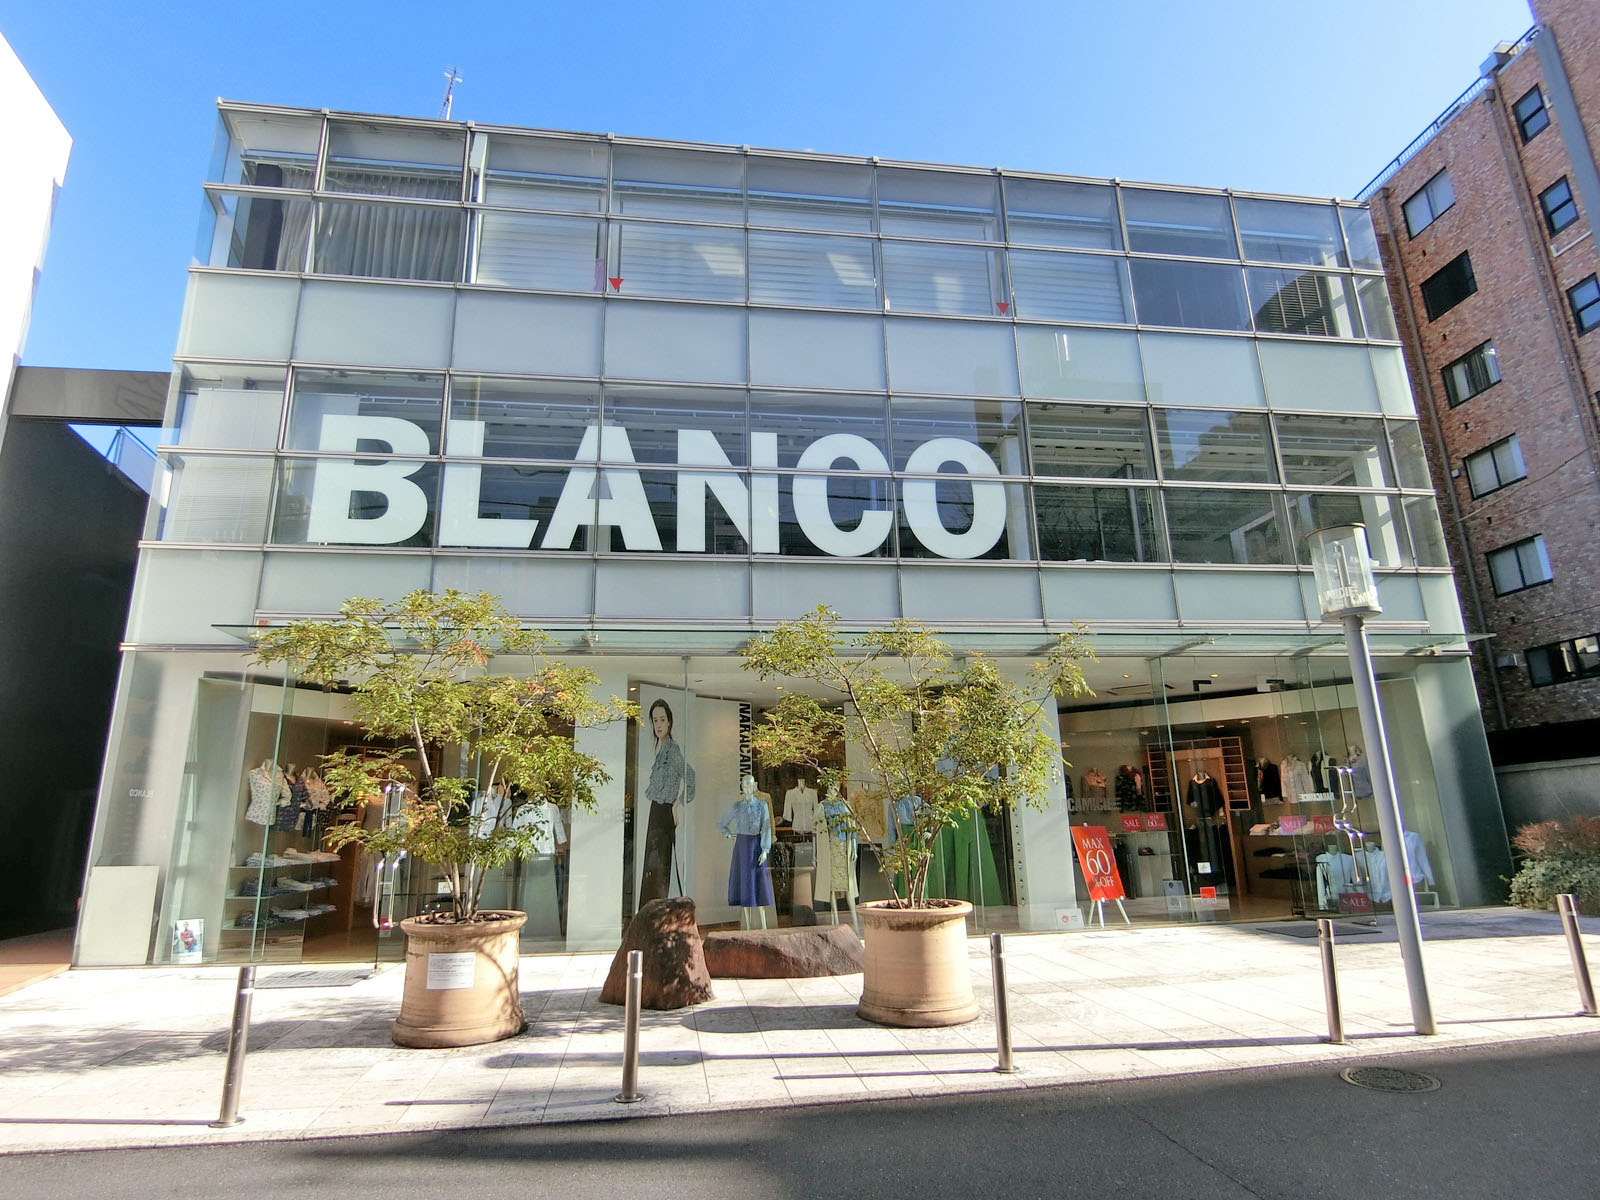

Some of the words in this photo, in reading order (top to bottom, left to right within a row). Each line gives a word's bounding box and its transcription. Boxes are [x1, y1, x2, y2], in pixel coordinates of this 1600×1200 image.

[307, 413, 1008, 560] BLANCO
[739, 703, 752, 795] NARACAM
[1123, 819, 1140, 827] SALE
[1081, 838, 1105, 849] MAX
[1086, 849, 1111, 876] 60
